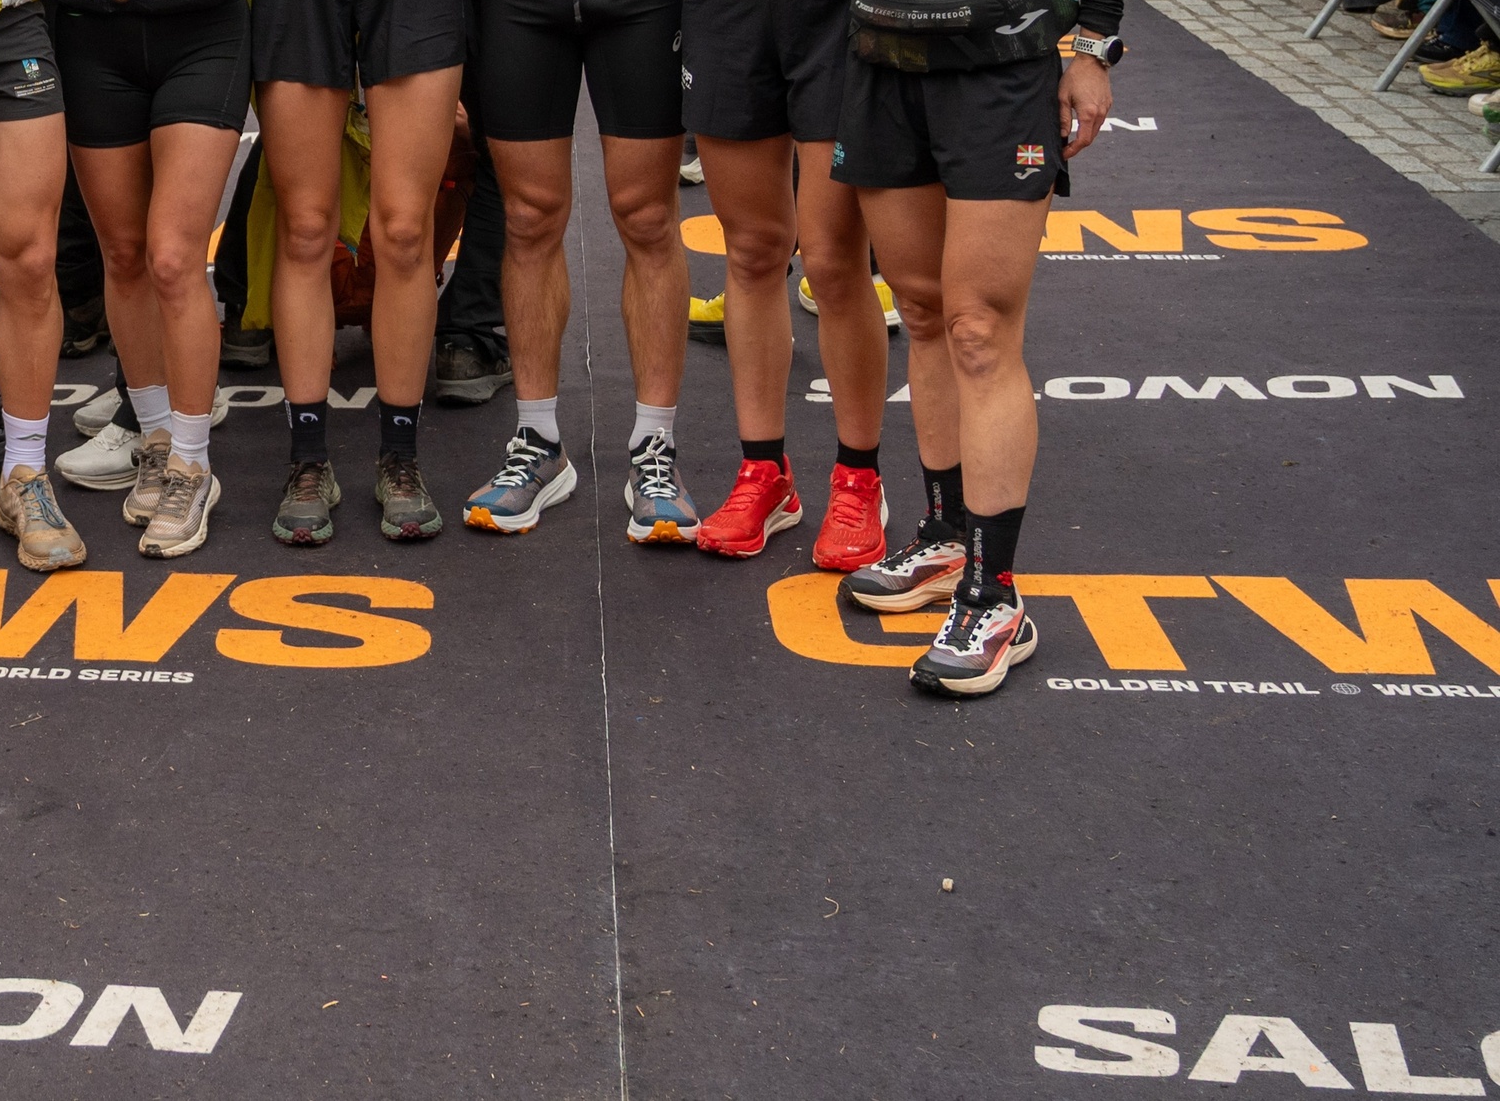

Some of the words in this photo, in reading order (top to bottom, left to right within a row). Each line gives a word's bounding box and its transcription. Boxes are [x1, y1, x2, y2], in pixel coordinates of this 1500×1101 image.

[874, 8, 906, 20] EXERCISE
[907, 11, 928, 20] YOUR
[931, 9, 971, 19] FREEDOM
[78, 668, 195, 684] SERIES
[1047, 677, 1199, 694] GOLDEN
[1203, 680, 1321, 696] TRAIL
[1374, 683, 1500, 698] WORL
[1033, 1003, 1500, 1097] SAL
